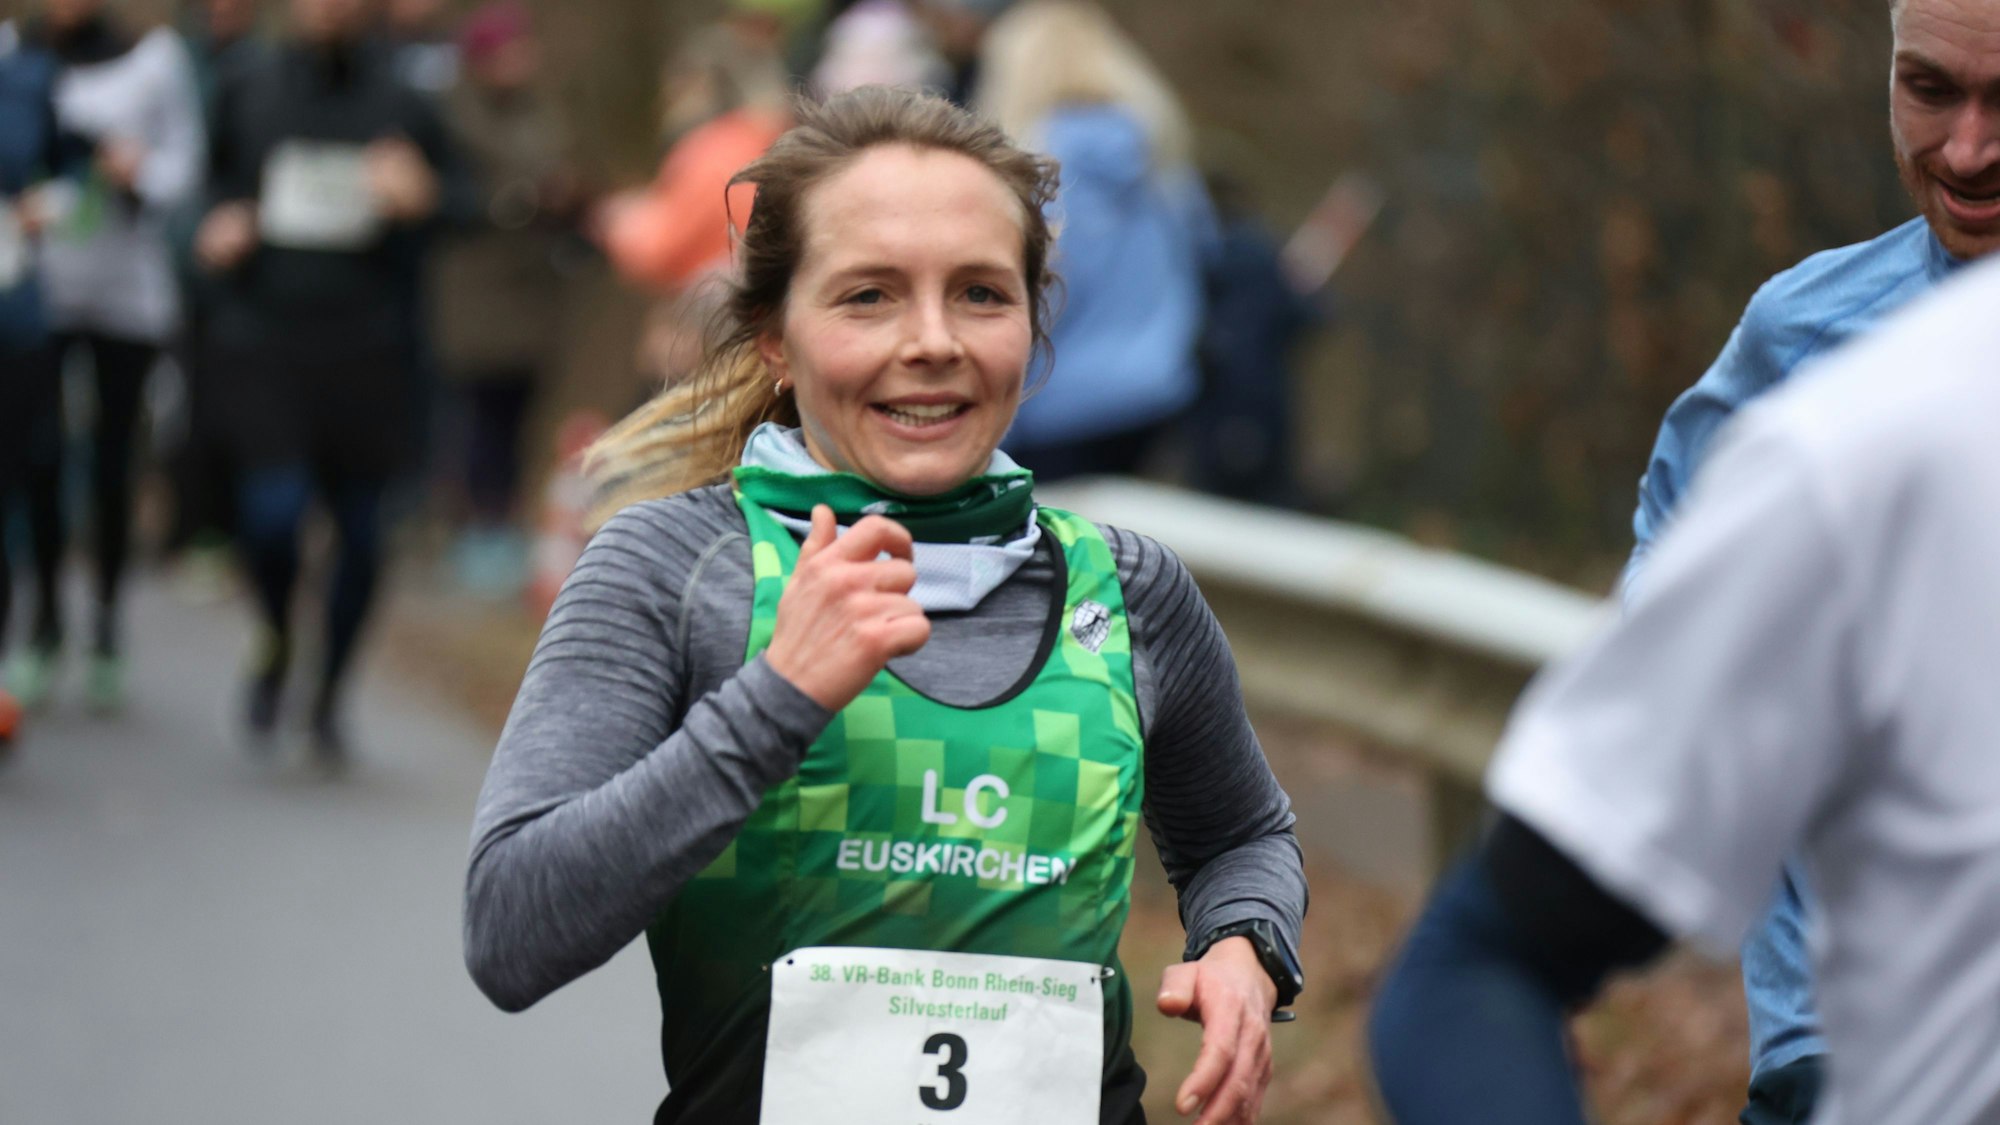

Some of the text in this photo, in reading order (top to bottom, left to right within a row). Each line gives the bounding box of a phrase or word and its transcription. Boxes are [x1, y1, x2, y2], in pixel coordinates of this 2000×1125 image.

[921, 769, 1009, 829] LC
[836, 839, 1076, 885] EUSKIRCHEN
[809, 964, 1077, 1001] 38. VR-Bank Bonn Rhein-Sieg
[889, 996, 1008, 1021] Silvesterlauf
[918, 1032, 968, 1112] 3
